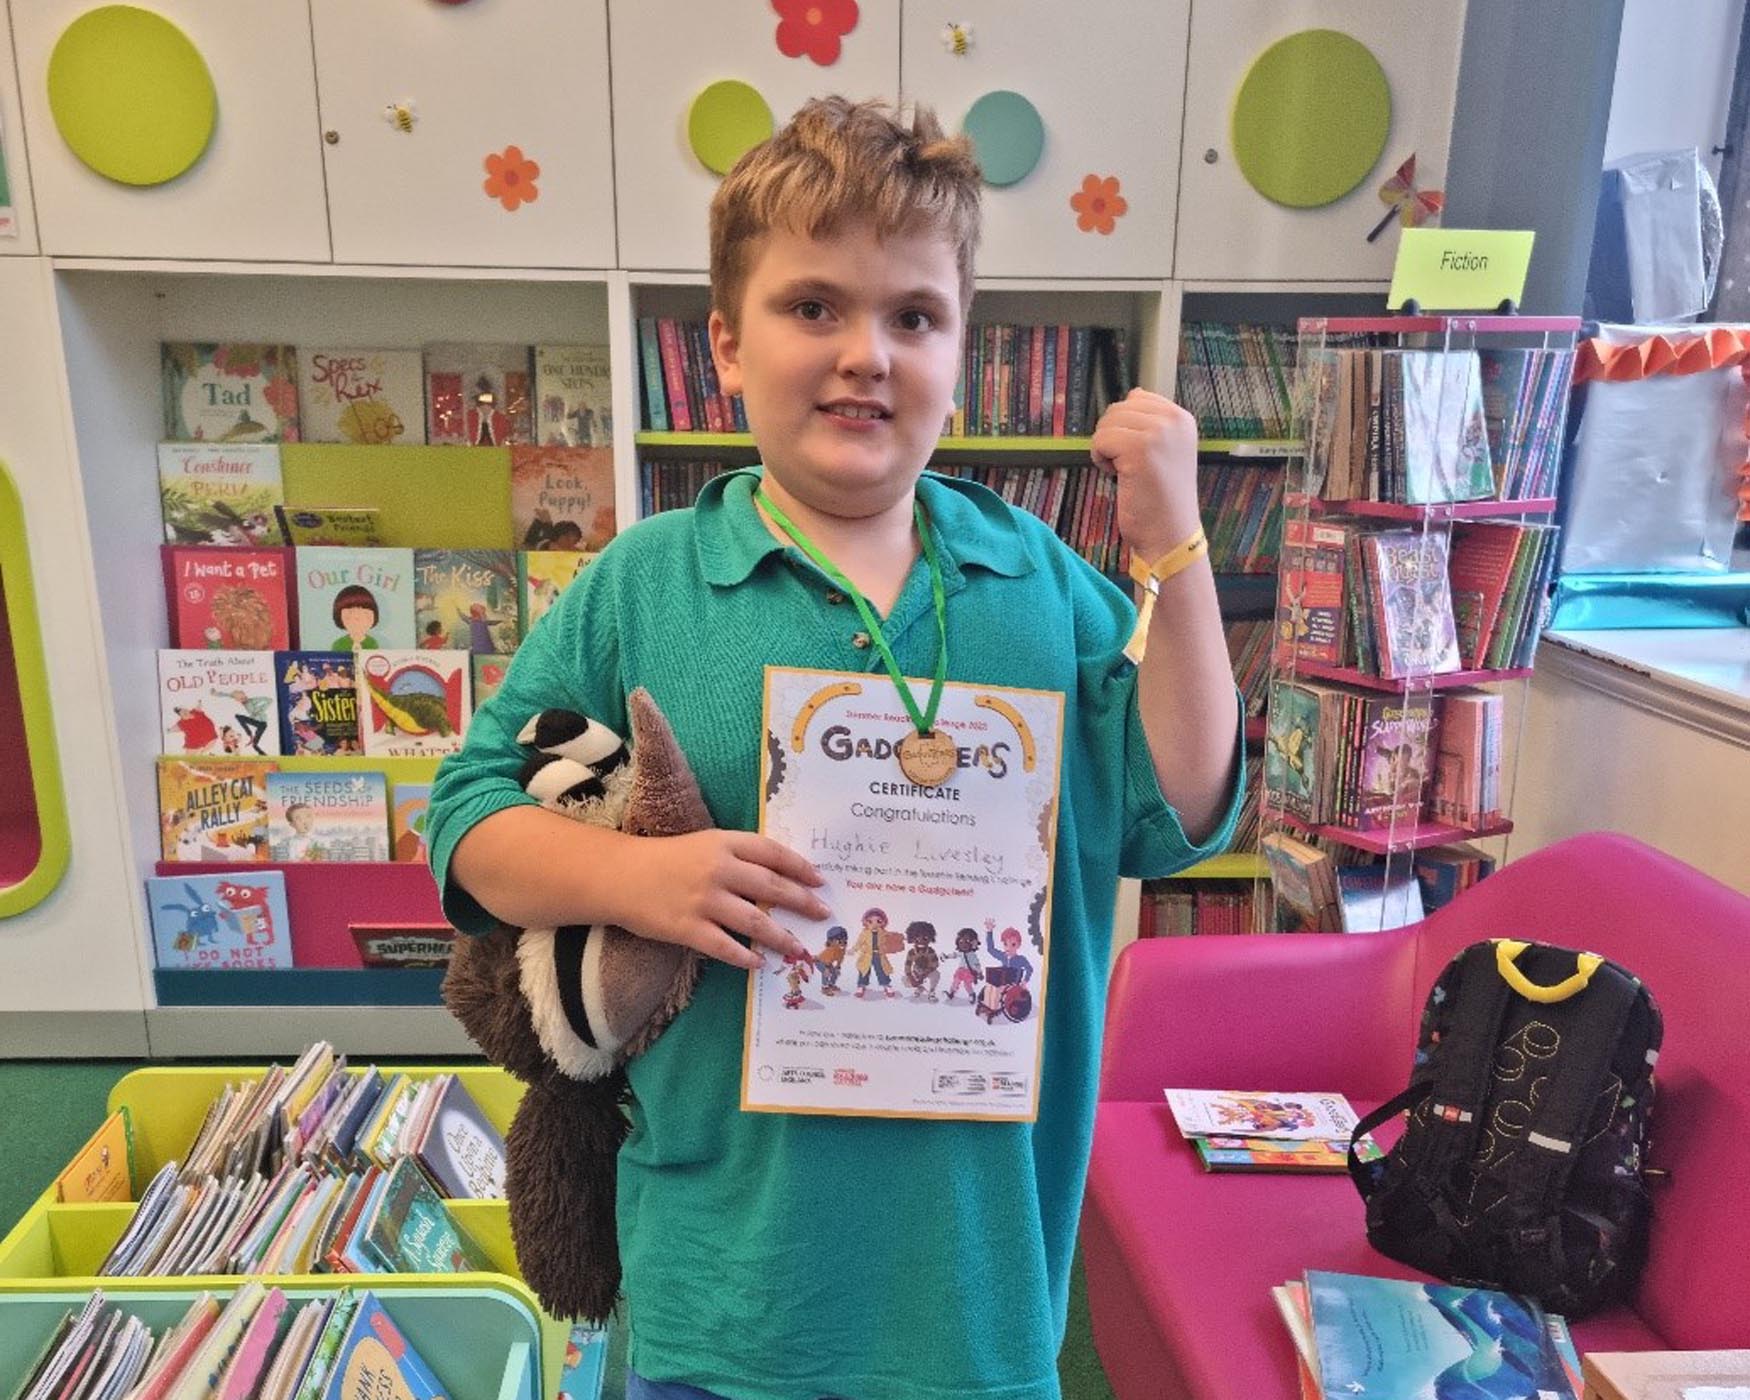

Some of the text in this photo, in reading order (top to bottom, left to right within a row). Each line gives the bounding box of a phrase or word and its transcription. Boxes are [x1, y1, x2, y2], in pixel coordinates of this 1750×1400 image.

[1439, 251, 1489, 272] Fiction
[312, 354, 367, 387] Specs
[202, 383, 250, 406] Tad
[335, 371, 383, 402] Rex
[183, 560, 277, 580] I Want a Pet
[308, 563, 401, 592] Our Girl
[416, 563, 496, 589] The Kiss
[177, 656, 255, 669] The Truth About
[167, 669, 269, 692] OLD PEOPLE
[187, 775, 254, 812] ALLEY CAT
[280, 785, 300, 794] THE
[304, 780, 352, 794] SEEDS
[869, 782, 962, 802] CERTIFICATE
[200, 802, 241, 831] RALLY
[850, 803, 977, 827] Congratulations
[811, 827, 890, 862] Hughie
[198, 950, 220, 961] DO
[230, 946, 264, 961] NOT
